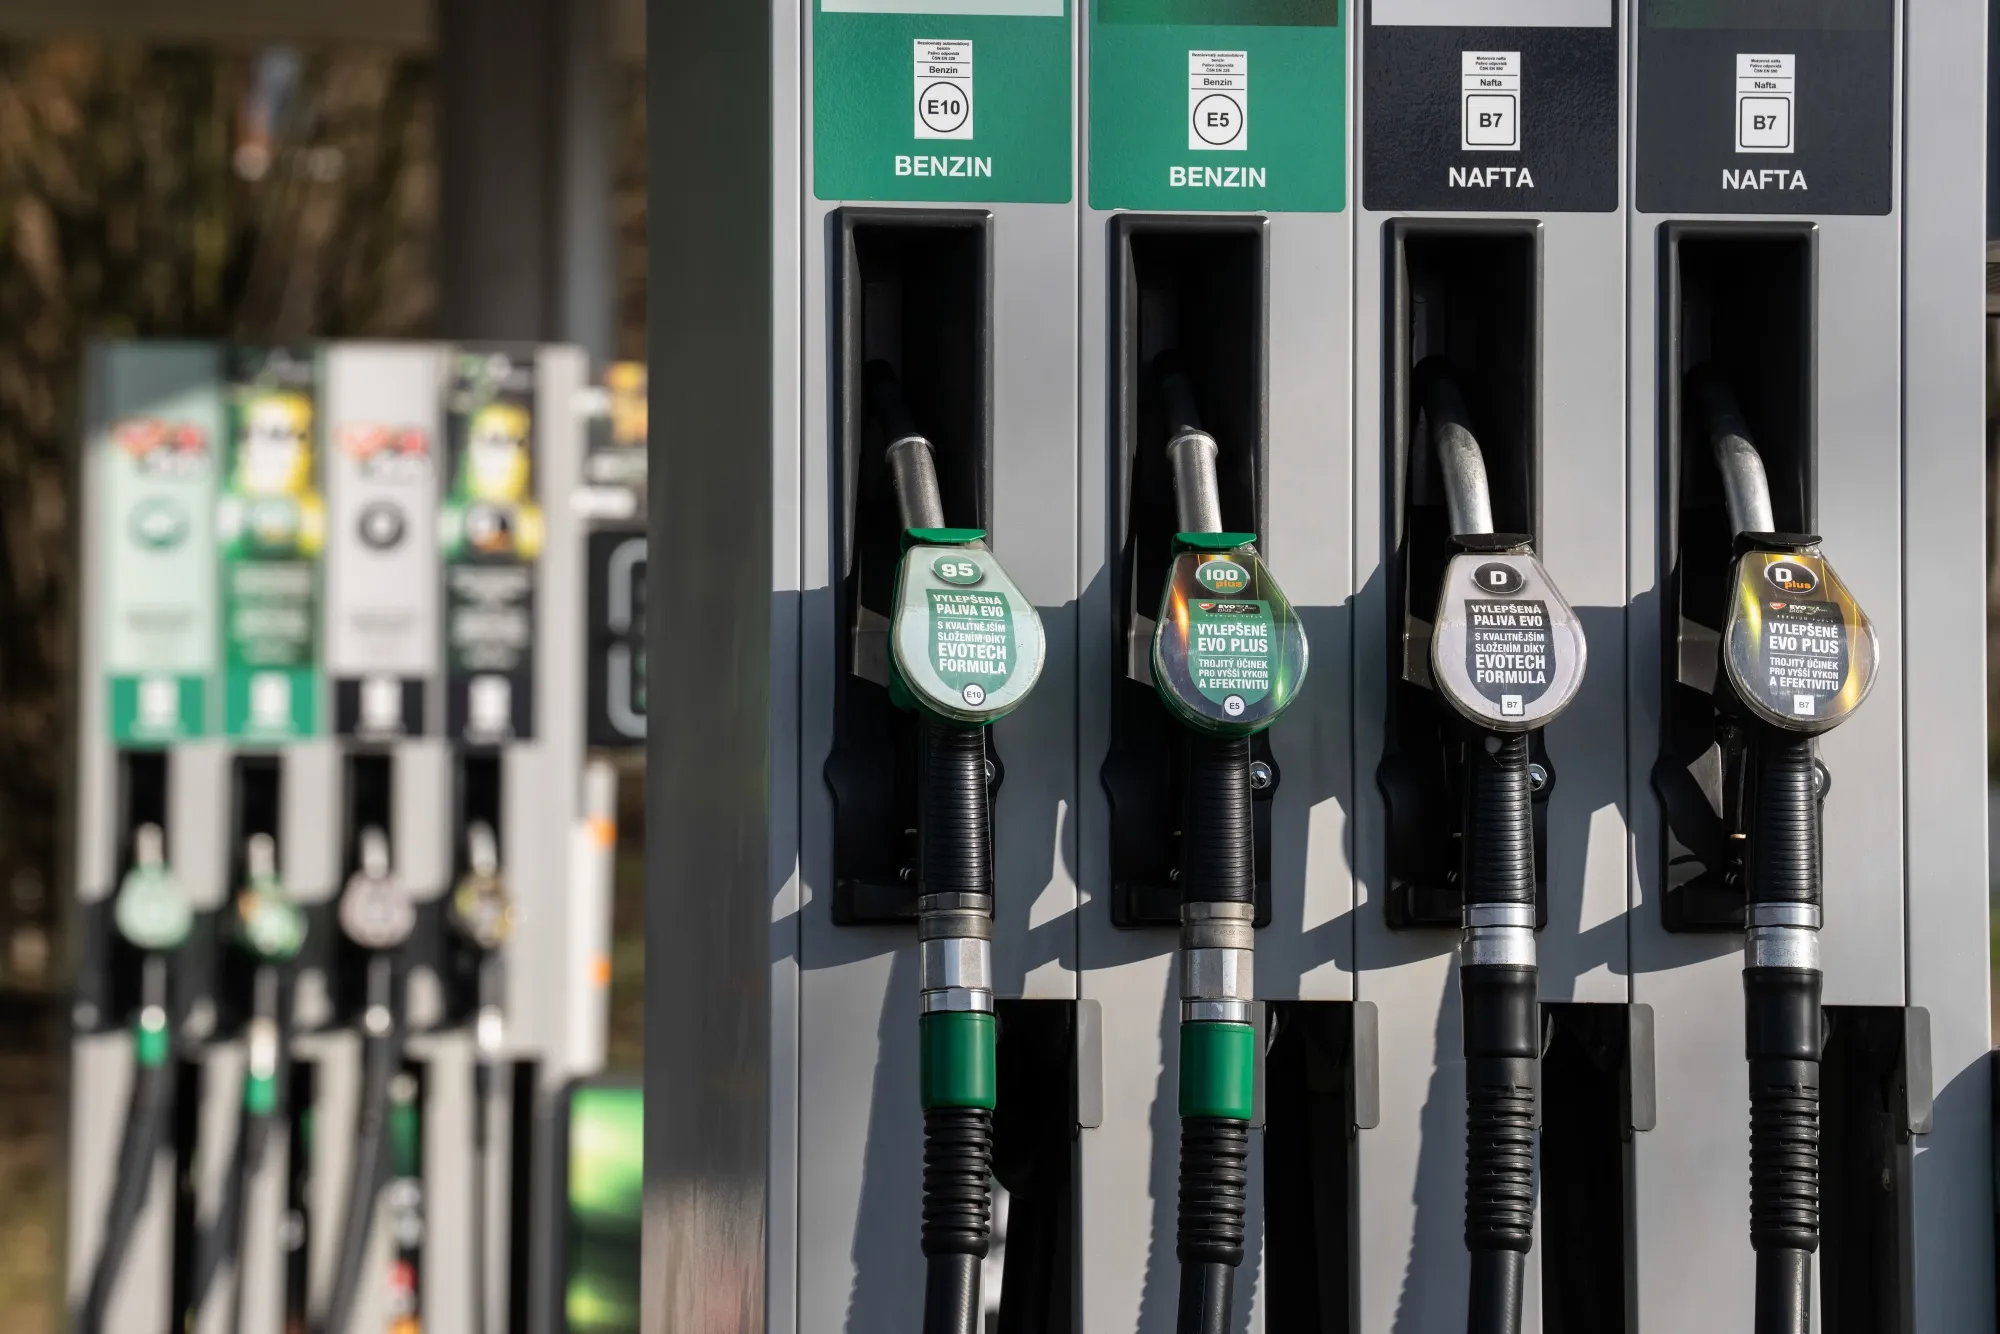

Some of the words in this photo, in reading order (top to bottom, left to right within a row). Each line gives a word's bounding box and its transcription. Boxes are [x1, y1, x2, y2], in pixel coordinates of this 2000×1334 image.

[929, 66, 958, 74] Benzin
[1204, 78, 1232, 86] Benzin
[1754, 81, 1776, 89] Nafta
[928, 100, 960, 115] E10
[1208, 113, 1229, 127] E5
[1480, 113, 1503, 127] B7
[1754, 115, 1777, 130] B7
[895, 156, 991, 177] BENZIN
[1170, 167, 1266, 187] BENZIN
[1449, 167, 1534, 188] NAFTA
[1723, 169, 1808, 190] NAFTA
[941, 563, 974, 577] 95
[1206, 569, 1238, 580] 100
[1775, 568, 1792, 582] D
[1490, 571, 1507, 584] D
[1216, 580, 1242, 589] plus
[1784, 581, 1811, 590] plus
[933, 594, 1002, 605] VYLEPŠENÁ
[936, 604, 978, 616] PALIVA
[981, 606, 1004, 617] EVO
[1471, 604, 1541, 614] VYLEPŠENÁ
[937, 621, 943, 629] S
[1473, 615, 1516, 626] PALIVA
[1520, 616, 1543, 626] EVO
[1198, 623, 1267, 636] VYLEPŠENÉ
[1769, 622, 1838, 638] VYLEPŠENÉ
[938, 631, 982, 642] SLOŽENÍM
[985, 633, 1006, 643] DÍKY
[1483, 632, 1544, 641] KVALITNĚJŠÍM
[939, 643, 1006, 659] EVOTECH
[1198, 637, 1226, 652] EVO
[1231, 638, 1268, 652] PLUS
[1475, 642, 1521, 652] SLOŽENÍM
[1524, 643, 1545, 653] DÍKY
[1769, 636, 1797, 651] EVO
[1801, 639, 1839, 654] PLUS
[940, 658, 1007, 674] FORMULA
[1199, 658, 1234, 668] TROJITÝ
[1236, 659, 1268, 669] ÚČINEK
[1475, 655, 1546, 669] EVOTECH
[1770, 657, 1805, 667] TROJITÝ
[1807, 659, 1838, 670] ÚČINEK
[1217, 669, 1240, 677] VYŠŠÍ
[1242, 670, 1268, 678] VÝKON
[1476, 670, 1546, 683] FORMULA
[1770, 667, 1785, 676] PRO
[1788, 668, 1810, 677] VYŠŠÍ
[1812, 670, 1838, 679] VÝKON
[1199, 680, 1206, 688] A
[1210, 679, 1268, 689] EFEKTIVITU
[1769, 677, 1777, 686] A
[1780, 678, 1839, 690] EFEKTIVITU
